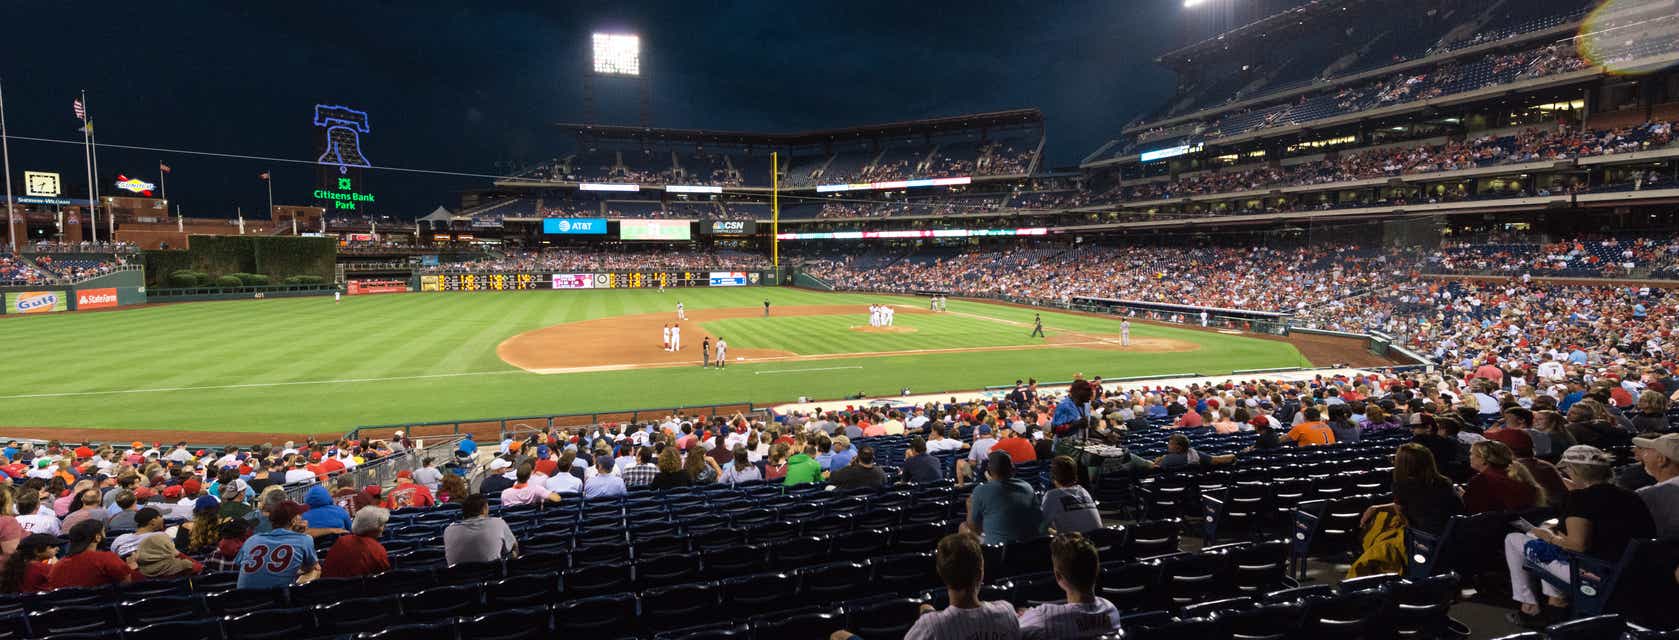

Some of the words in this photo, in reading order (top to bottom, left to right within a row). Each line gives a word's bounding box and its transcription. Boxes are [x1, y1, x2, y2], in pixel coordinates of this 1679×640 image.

[314, 190, 351, 200] Citizens
[352, 192, 375, 202] Bank
[335, 201, 356, 210] Park
[572, 222, 592, 231] AT&T
[724, 221, 744, 230] CSN
[18, 295, 55, 309] Gulf
[241, 544, 295, 574] 39
